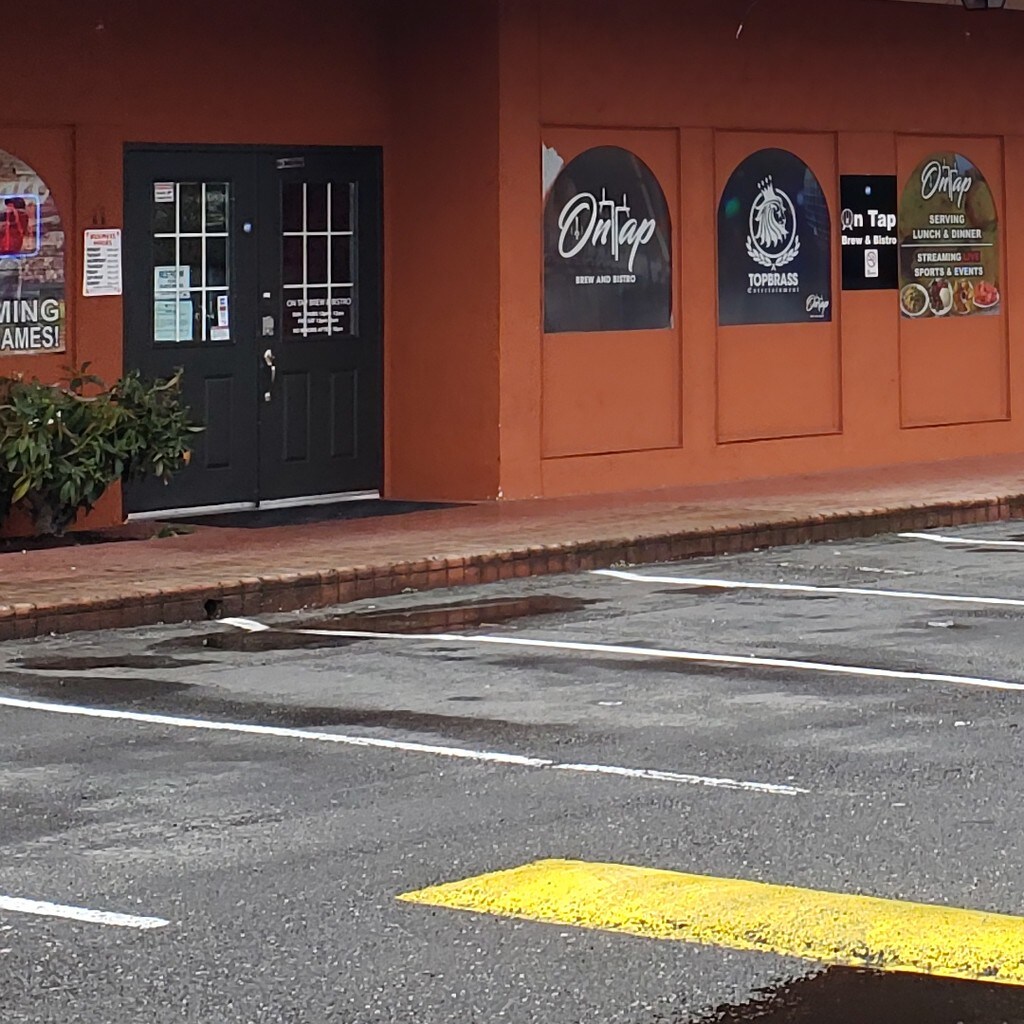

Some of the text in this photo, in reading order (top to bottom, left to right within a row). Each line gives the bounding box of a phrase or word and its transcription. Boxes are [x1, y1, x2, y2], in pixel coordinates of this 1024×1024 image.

[841, 208, 897, 232] On Tap
[929, 214, 965, 225] SERVING
[912, 228, 983, 240] LUNCH & DINNER
[841, 235, 898, 246] Brew & Bistro
[917, 252, 980, 263] STREAMING LIVE
[914, 266, 984, 277] SPORTS & EVENTS
[575, 274, 636, 285] BREW AND BISTRO
[748, 272, 799, 287] TOPBRASS
